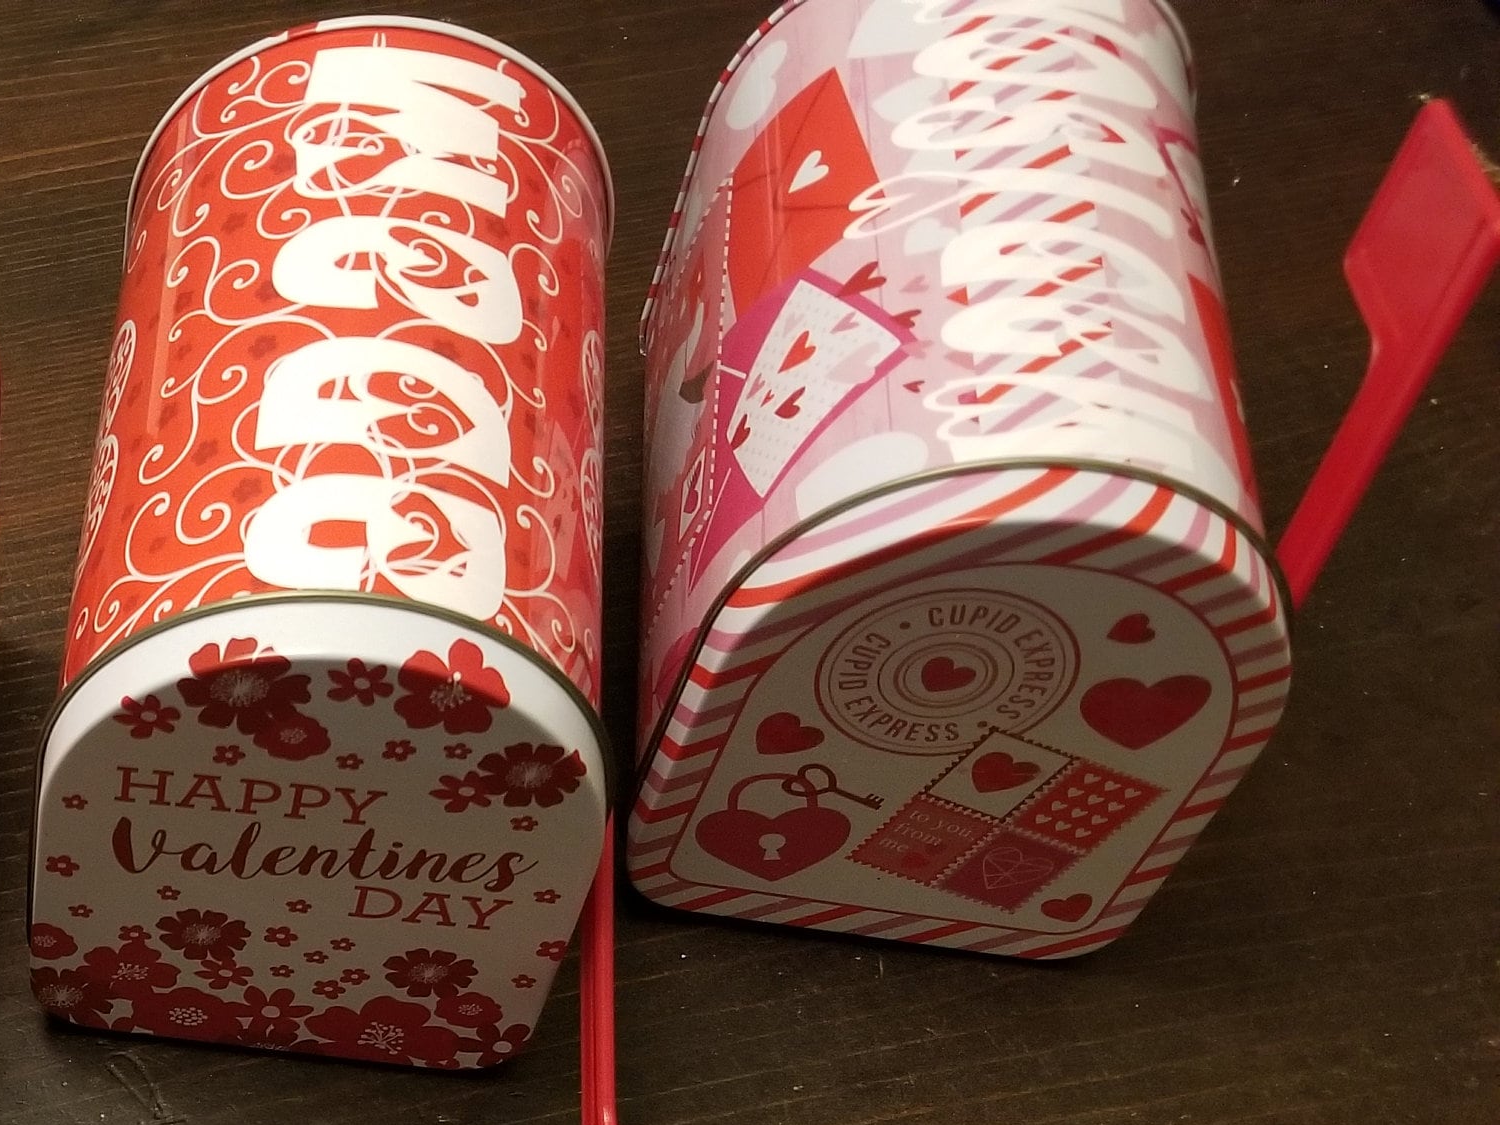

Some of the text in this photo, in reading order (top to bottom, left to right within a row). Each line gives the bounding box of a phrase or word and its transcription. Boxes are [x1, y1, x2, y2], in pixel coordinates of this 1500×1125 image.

[838, 632, 960, 743] CUPID EXPRESS
[927, 604, 1056, 720] CUPID EXPRESS
[113, 766, 388, 826] HAPPY
[111, 815, 538, 893] Valentines
[877, 837, 910, 853] me
[893, 821, 944, 847] from
[348, 885, 515, 931] DAY
